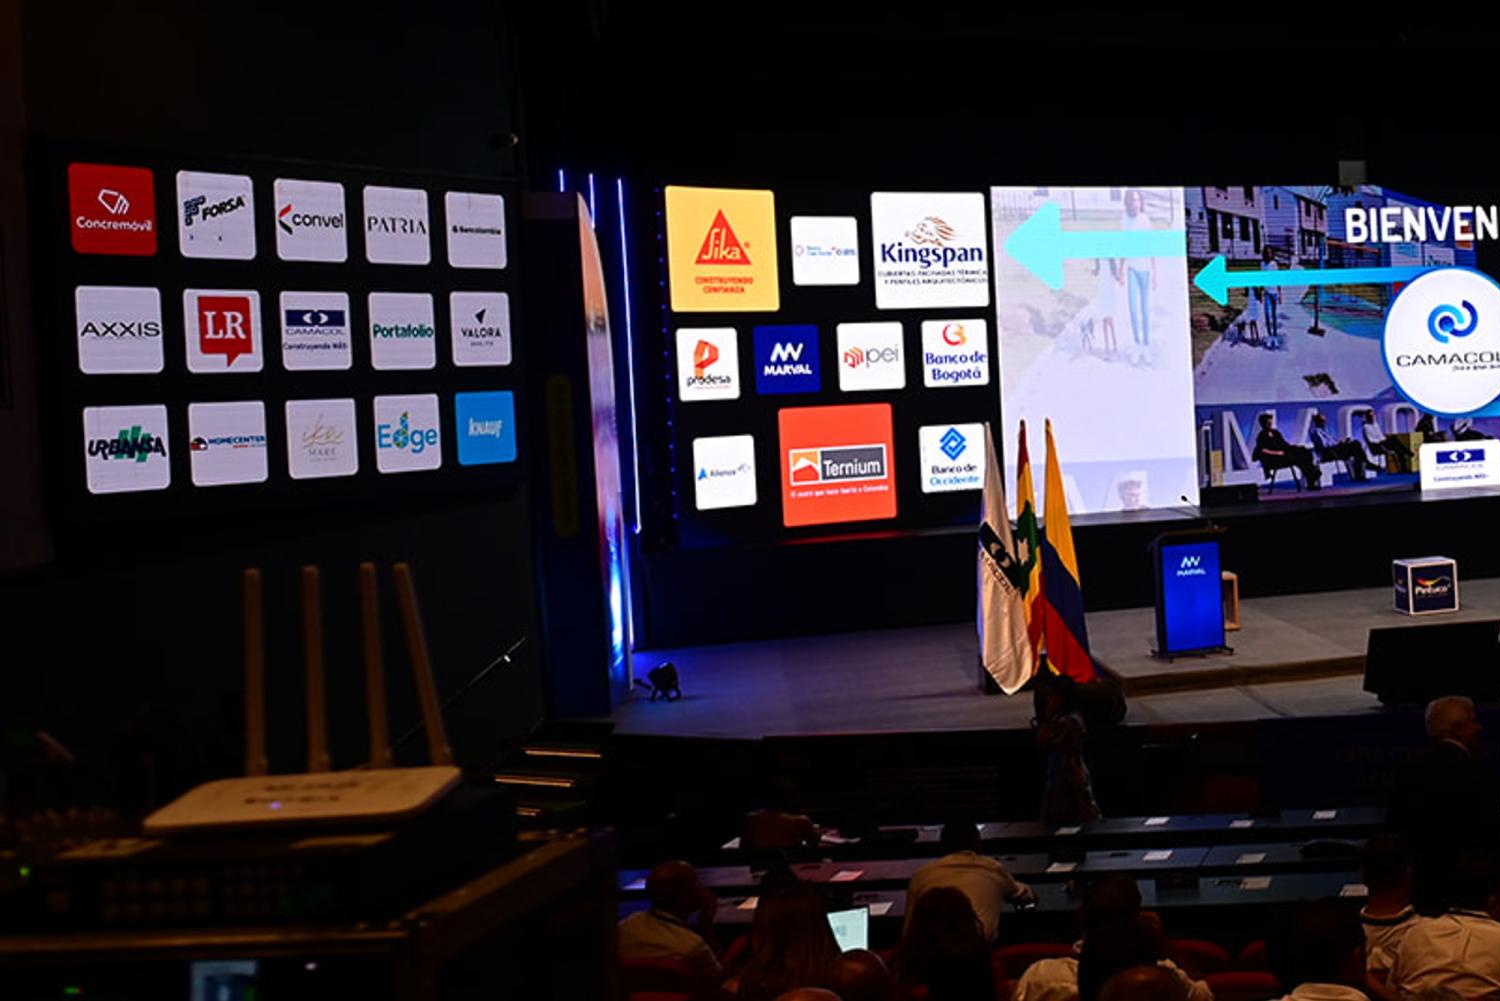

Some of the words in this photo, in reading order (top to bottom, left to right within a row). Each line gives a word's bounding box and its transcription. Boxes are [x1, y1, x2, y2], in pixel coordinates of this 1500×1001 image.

[202, 196, 246, 222] FORSA
[76, 216, 153, 232] Concremóvil
[292, 213, 344, 229] convel
[367, 216, 427, 235] PATRIA
[701, 227, 741, 260] Sika
[881, 242, 983, 269] Kingspan
[80, 321, 161, 338] AXXIS
[203, 311, 247, 340] LR
[372, 324, 434, 339] Portafolio
[461, 328, 502, 338] VALORA
[865, 344, 899, 368] pei
[925, 352, 968, 365] Banco
[969, 350, 987, 363] de
[764, 363, 813, 376] MARVAL
[931, 366, 982, 383] Bogotá
[377, 411, 438, 454] Edge
[88, 436, 166, 461] URBANSA
[823, 458, 881, 477] Ternium
